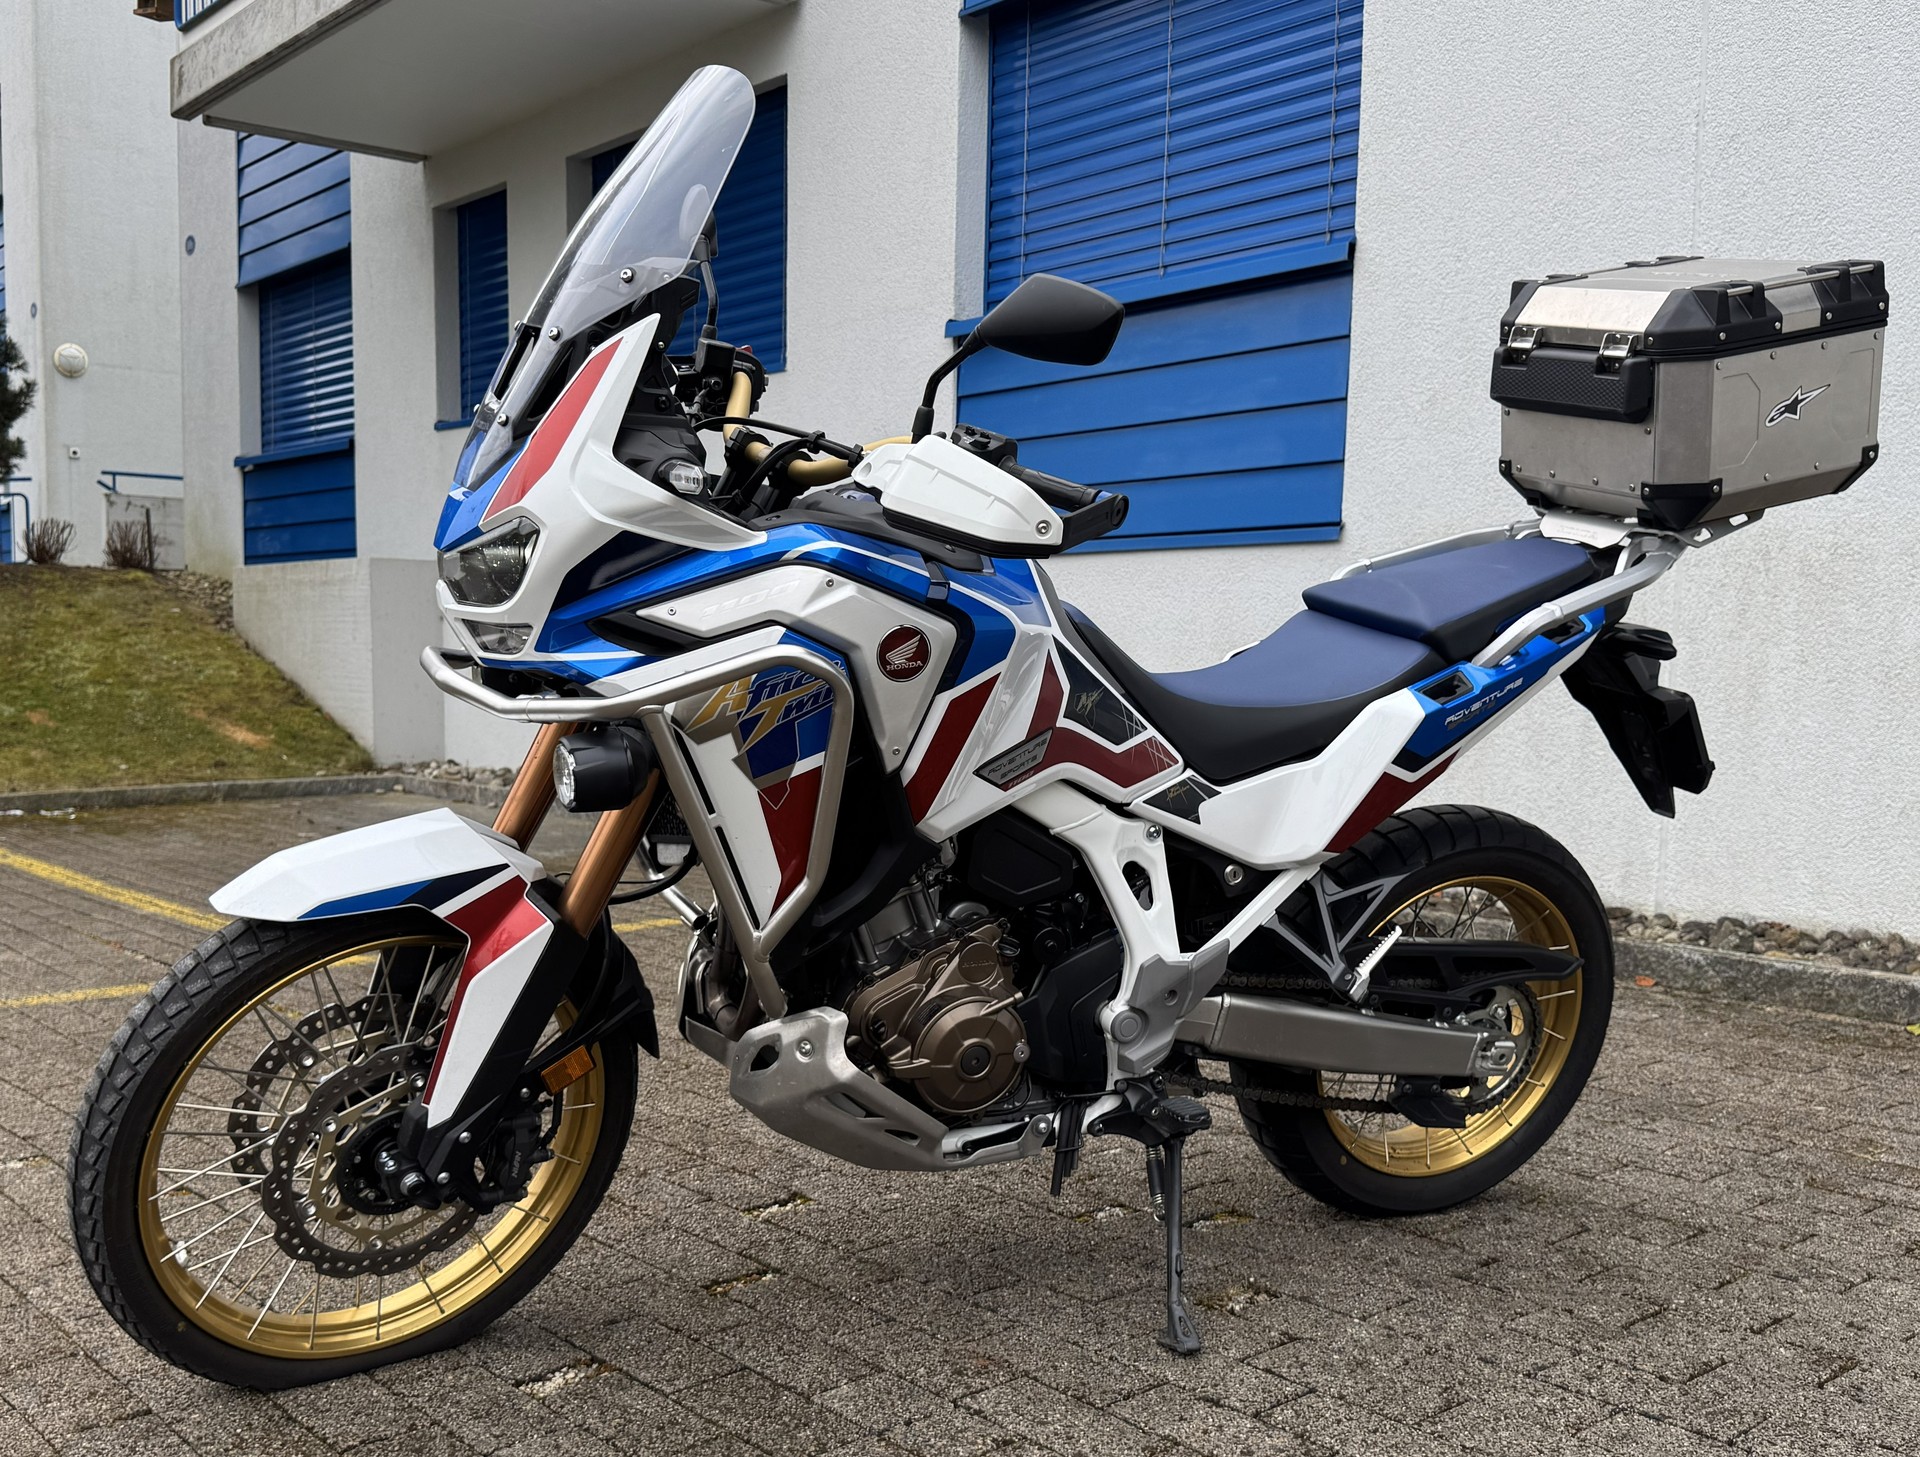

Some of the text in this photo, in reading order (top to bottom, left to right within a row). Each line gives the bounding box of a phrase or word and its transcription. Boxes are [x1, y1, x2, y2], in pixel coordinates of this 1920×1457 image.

[886, 660, 924, 671] HONDA
[1445, 677, 1523, 726] ADVENTURE
[987, 737, 1048, 776] ADVENTURE
